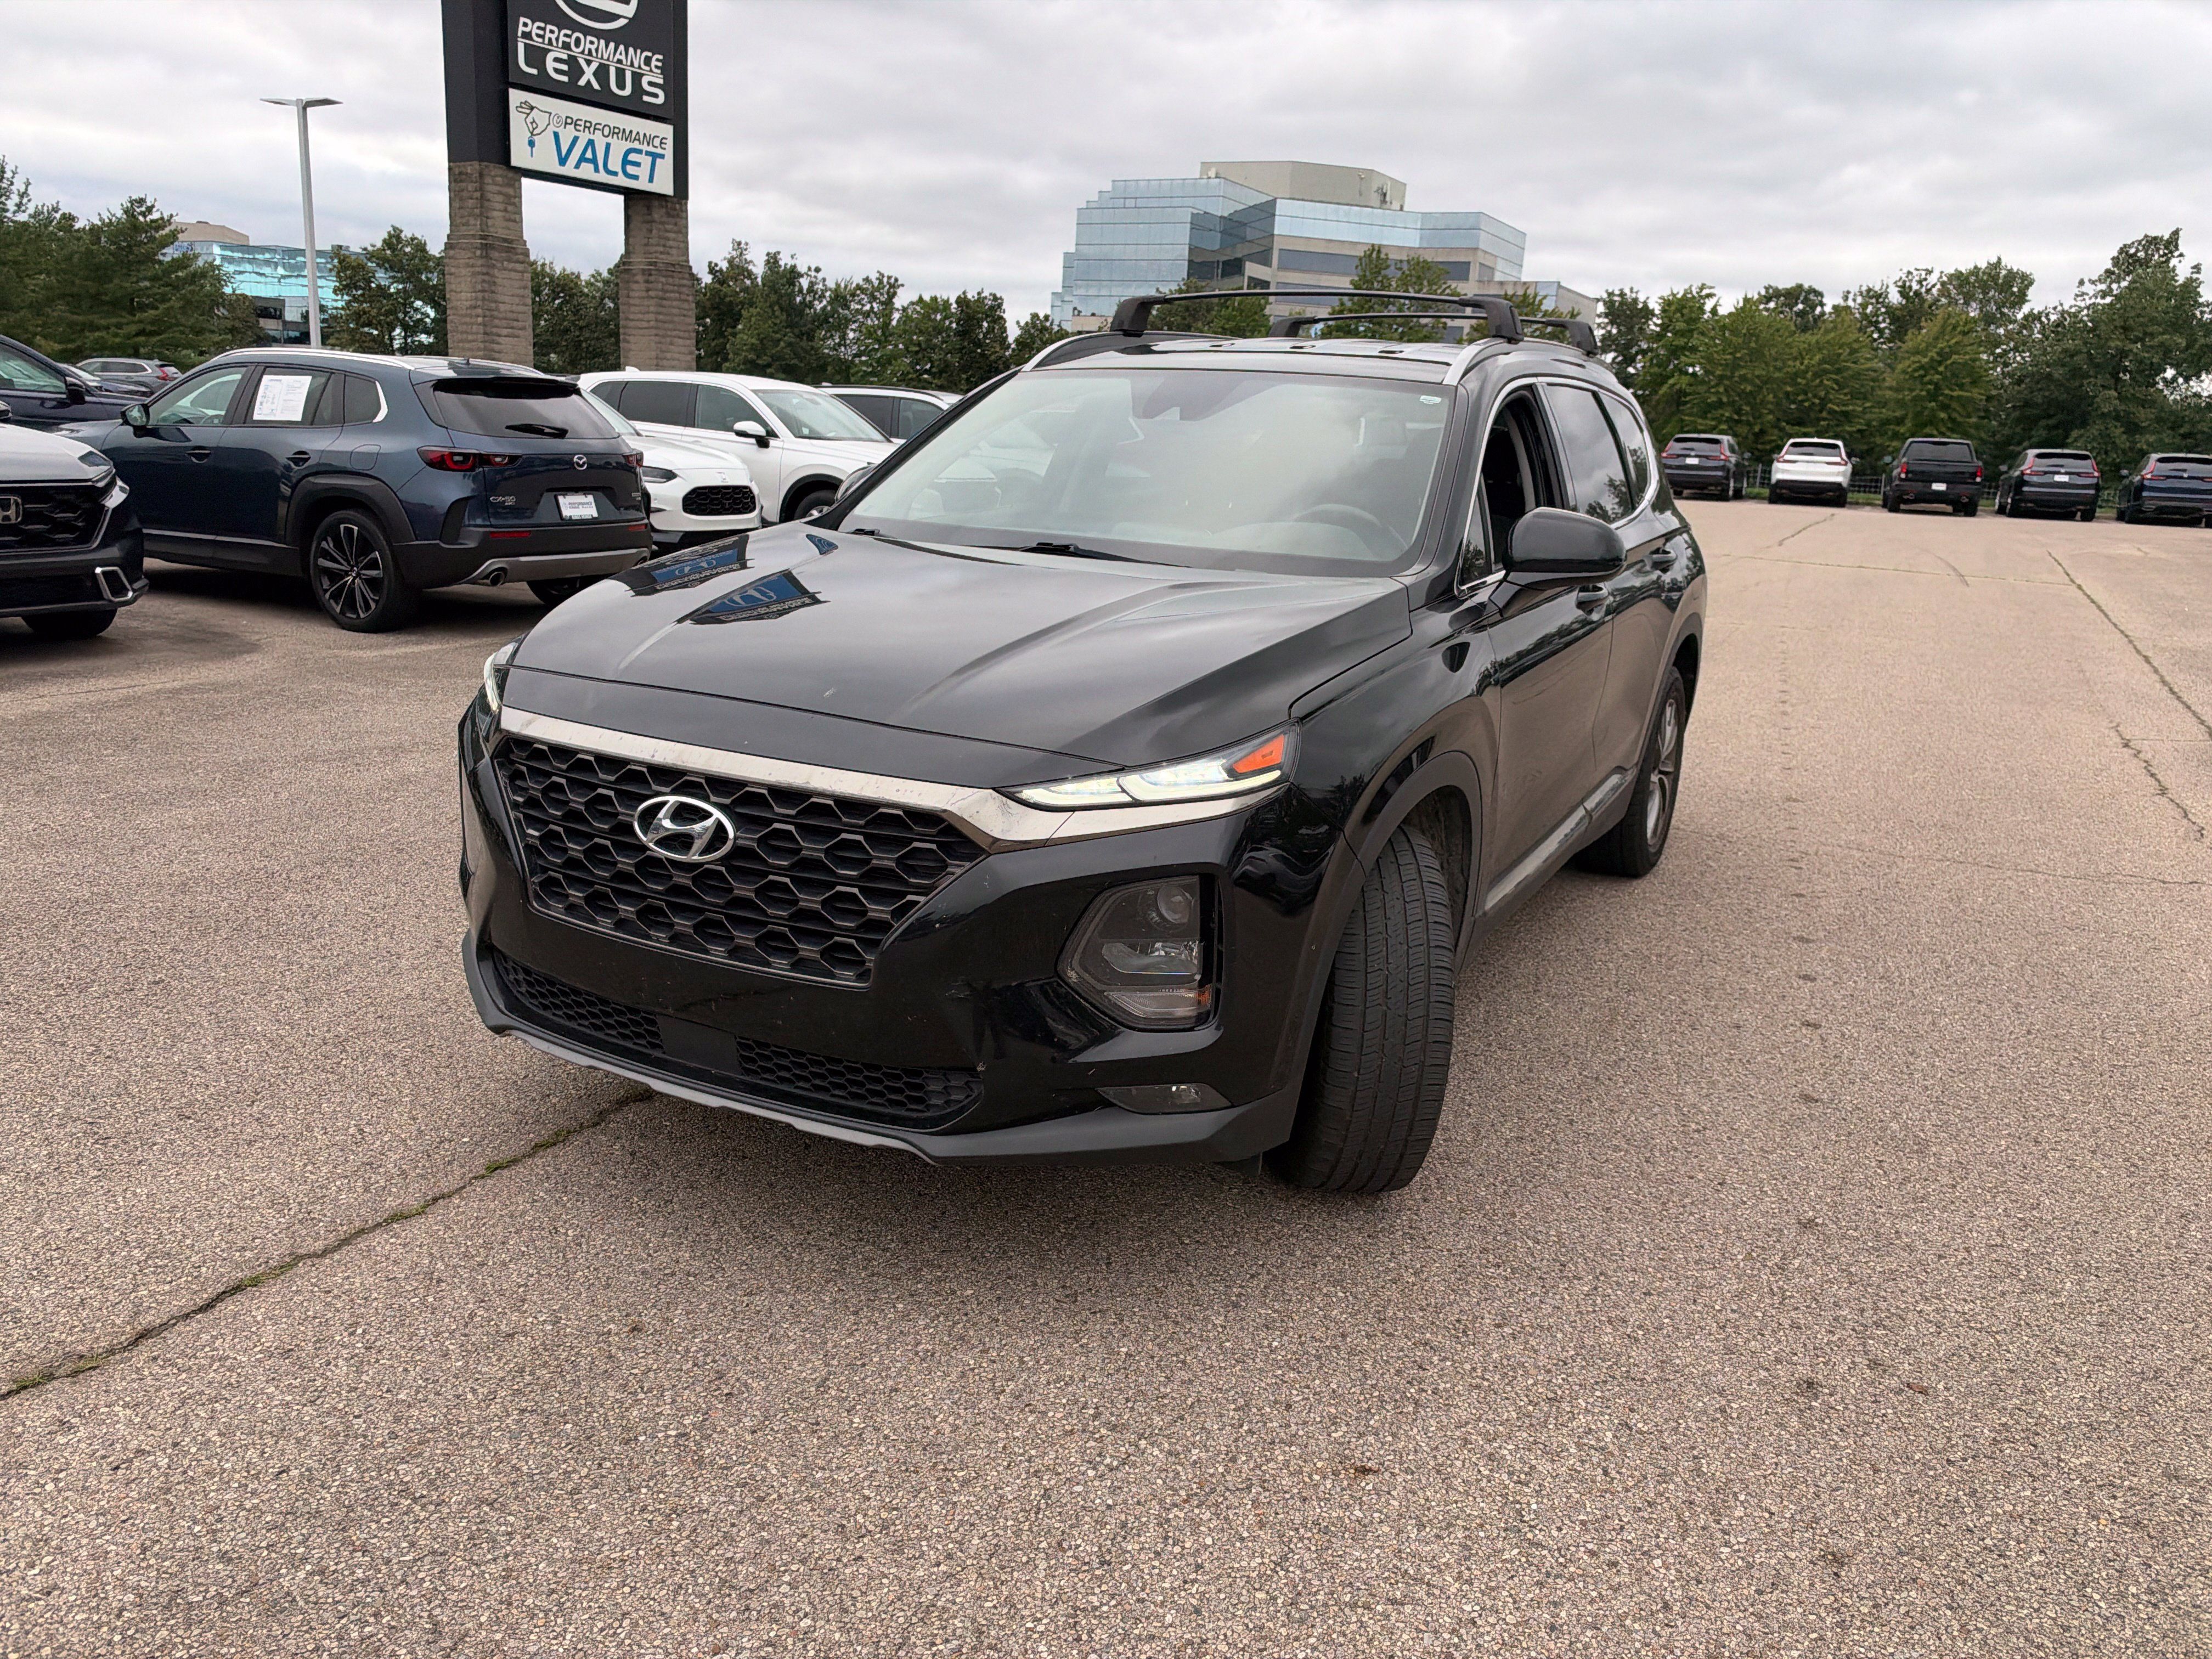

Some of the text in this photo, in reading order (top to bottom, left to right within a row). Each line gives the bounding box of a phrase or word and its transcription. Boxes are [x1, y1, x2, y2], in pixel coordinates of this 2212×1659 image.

[517, 16, 663, 74] PERFORMANCE
[517, 42, 665, 105] LEXUS
[552, 130, 665, 184] VALET
[563, 115, 668, 150] PERFORMANCE
